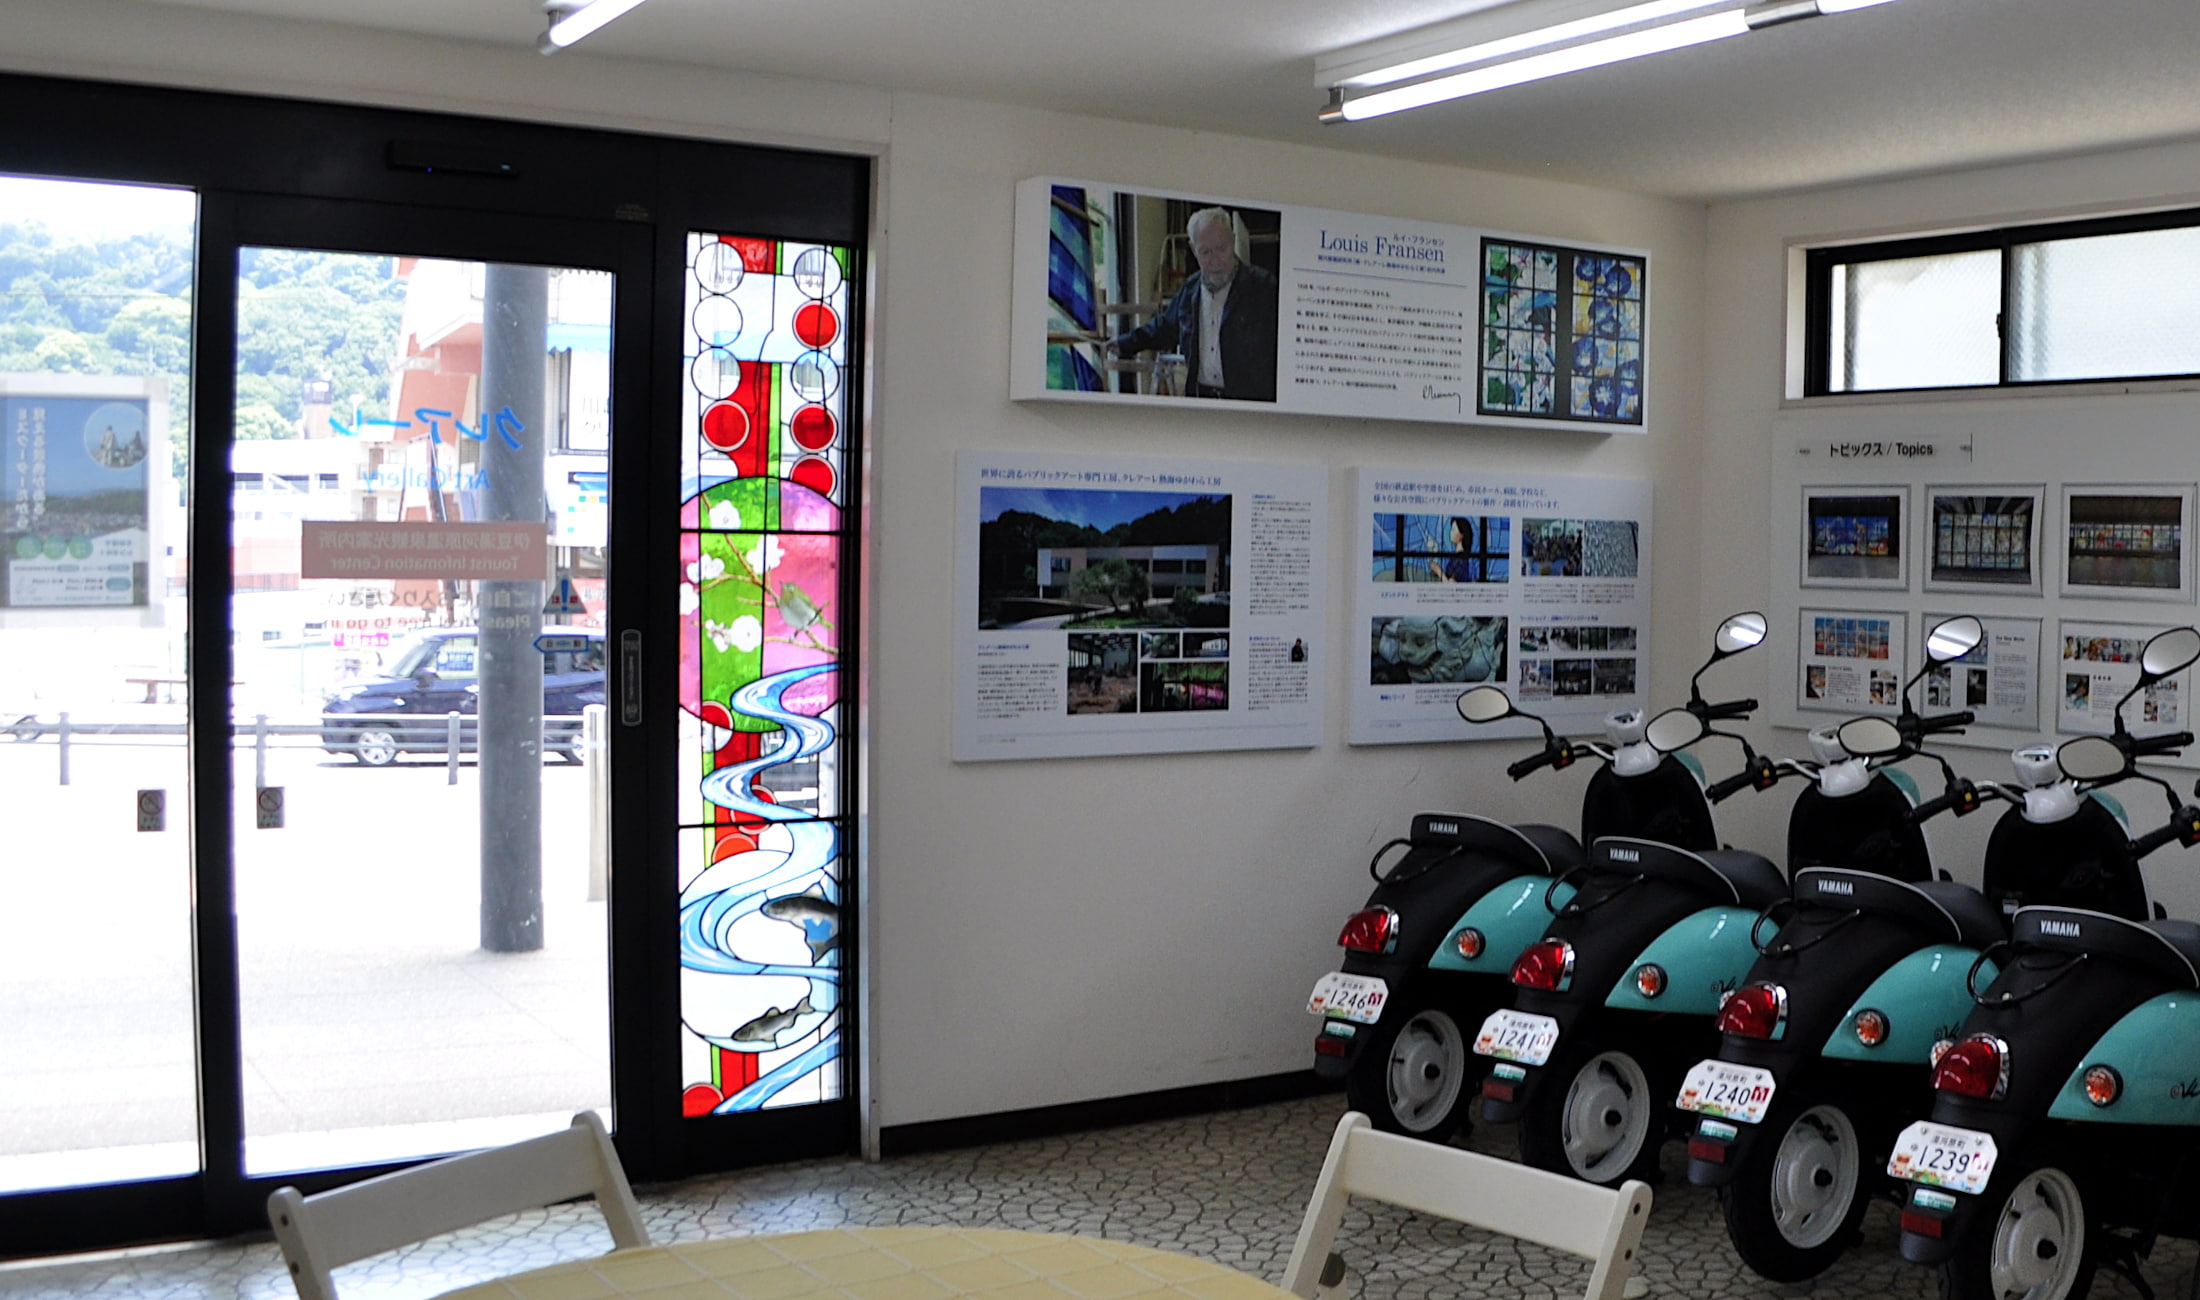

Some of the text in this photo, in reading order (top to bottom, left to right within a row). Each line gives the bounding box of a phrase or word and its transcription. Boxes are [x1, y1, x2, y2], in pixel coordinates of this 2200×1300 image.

[1320, 230, 1444, 262] Louis Fransen
[1392, 233, 1445, 247] ルイ・フランセン
[1829, 442, 1883, 458] トピックス
[1896, 441, 1934, 460] Topics
[1428, 821, 1459, 836] YAMAHA
[1608, 847, 1640, 863] YAMAHA
[1817, 879, 1854, 896] YAMAHA
[2039, 919, 2081, 938] YAMAHA
[1330, 989, 1368, 1010] 1246
[1498, 1028, 1537, 1051] 1241
[1705, 1081, 1751, 1106] 1240
[1931, 1135, 1966, 1149] 湯河原町
[1919, 1145, 1971, 1174] 1239
